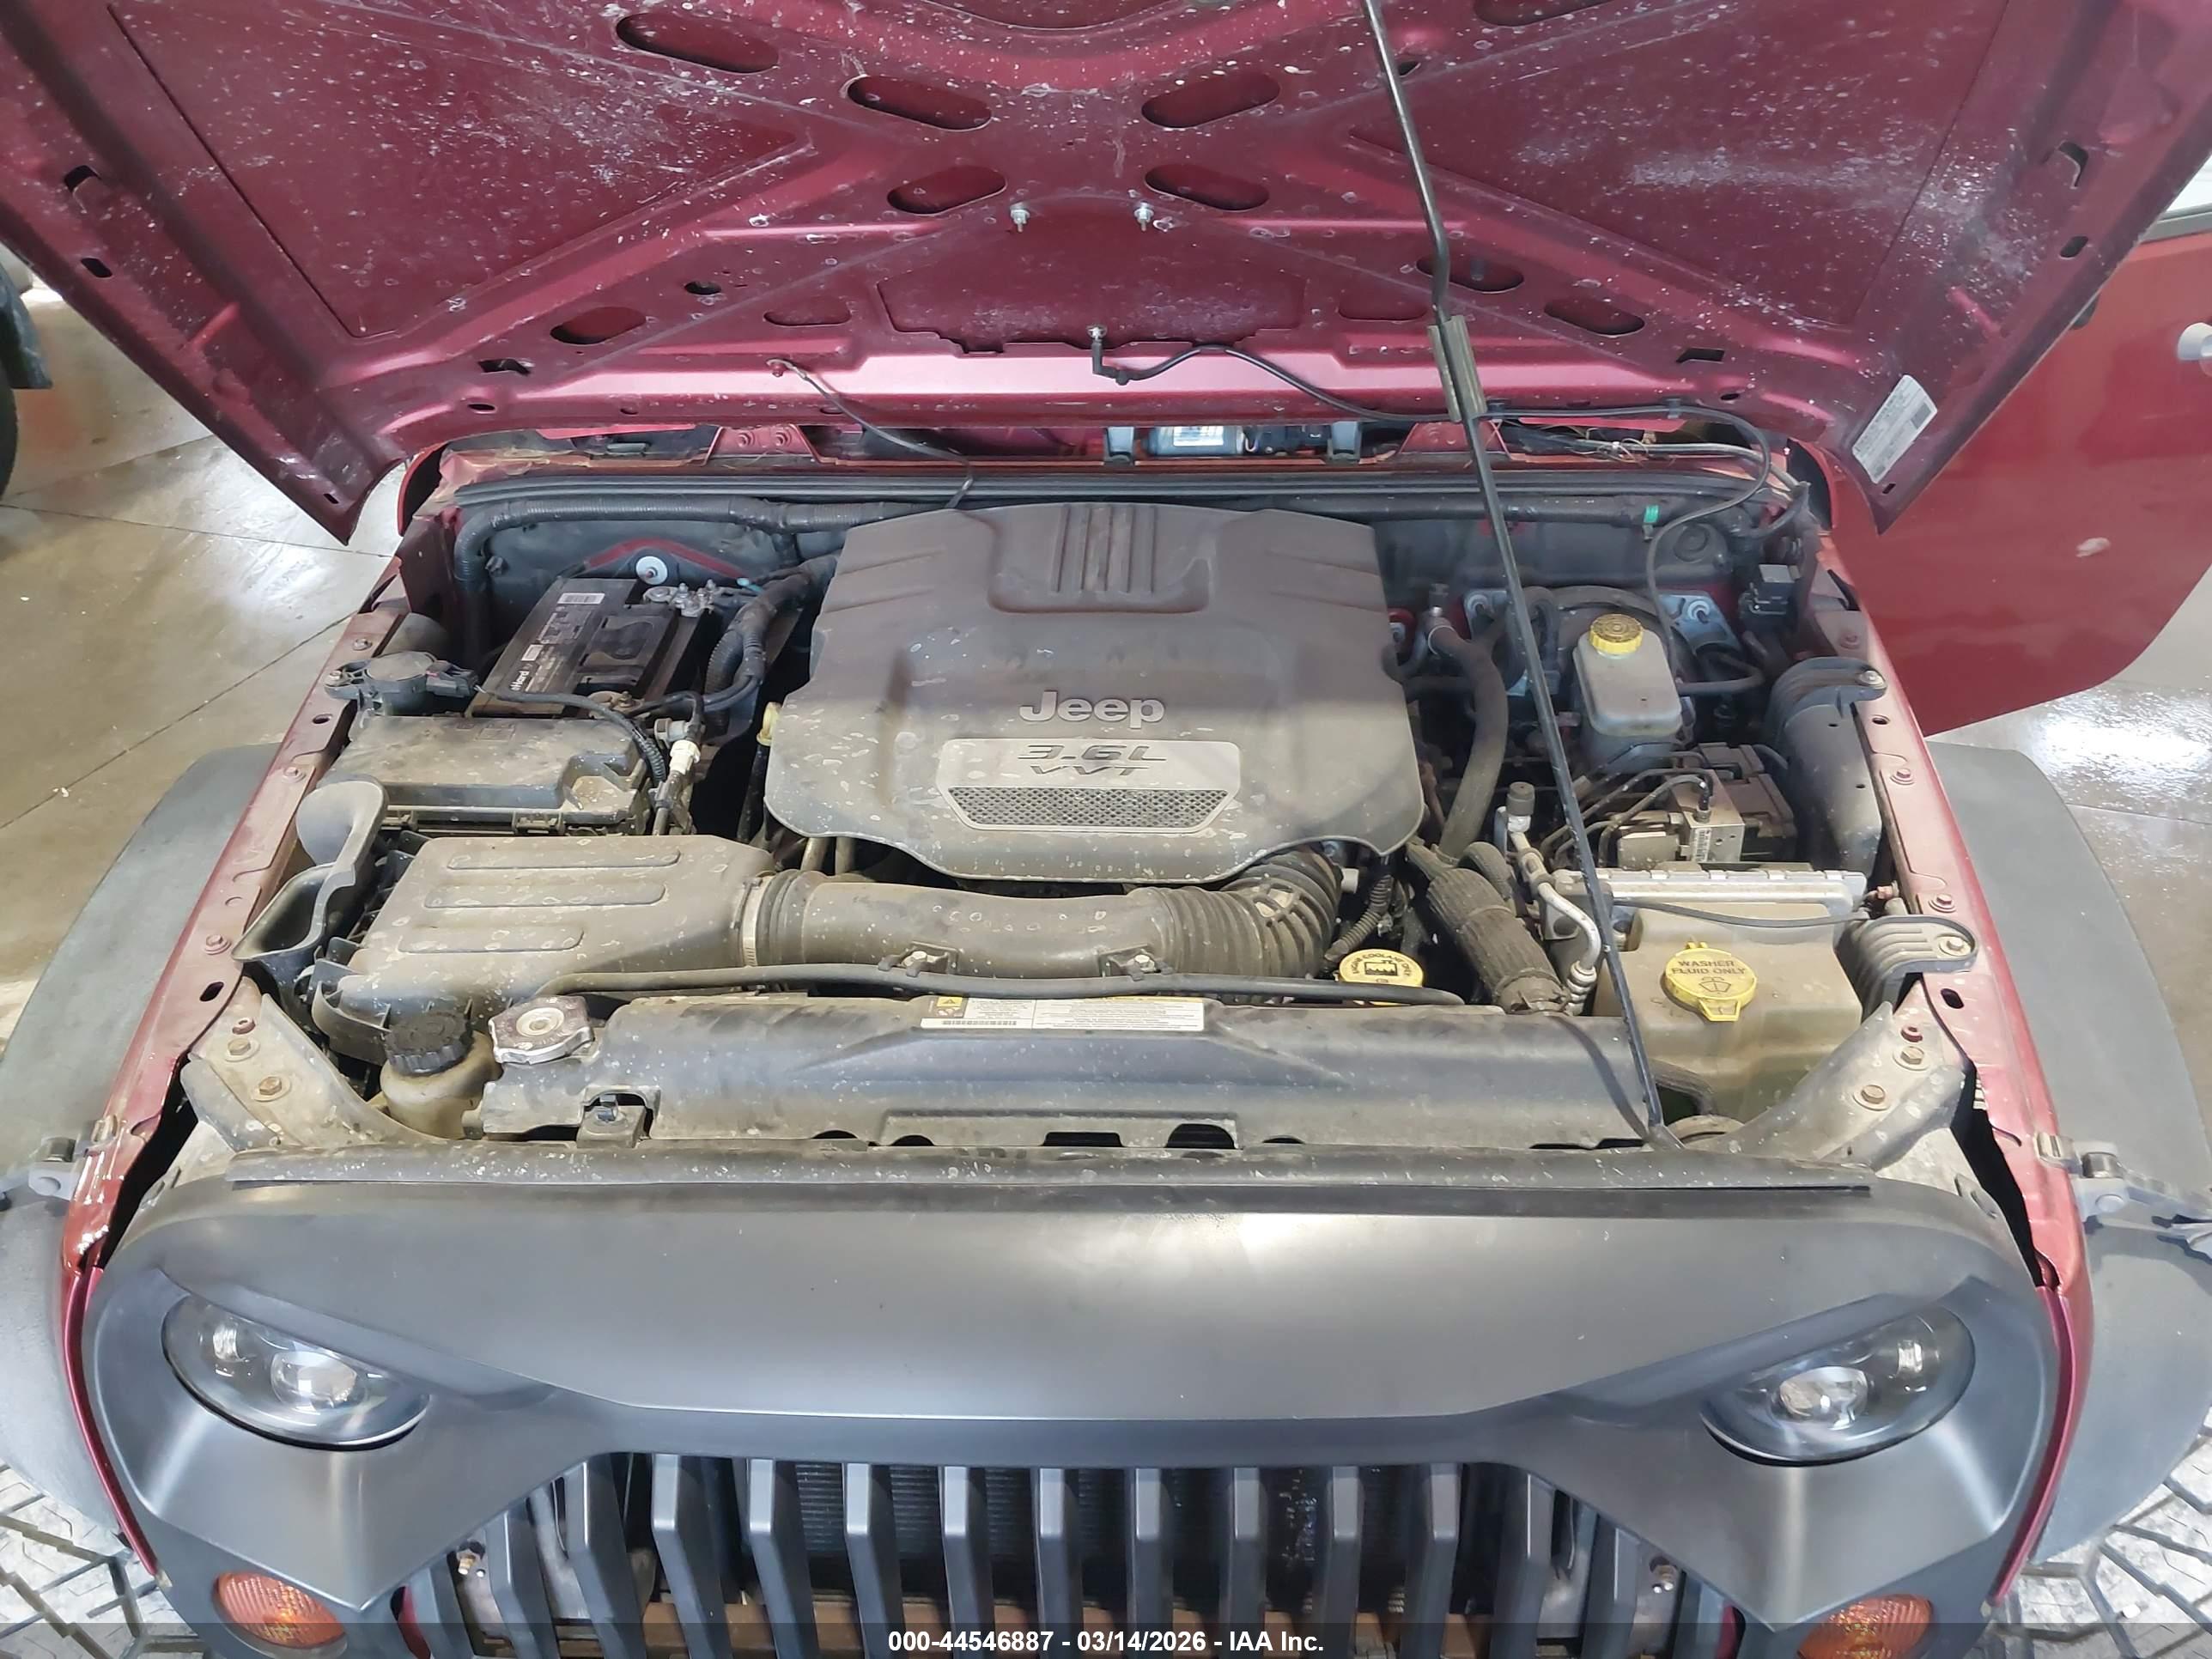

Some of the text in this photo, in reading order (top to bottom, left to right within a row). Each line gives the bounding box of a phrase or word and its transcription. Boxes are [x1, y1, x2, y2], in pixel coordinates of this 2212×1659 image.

[1018, 690, 1165, 728] Jeep
[1017, 744, 1167, 761] 3.6L
[1030, 764, 1152, 776] VVT
